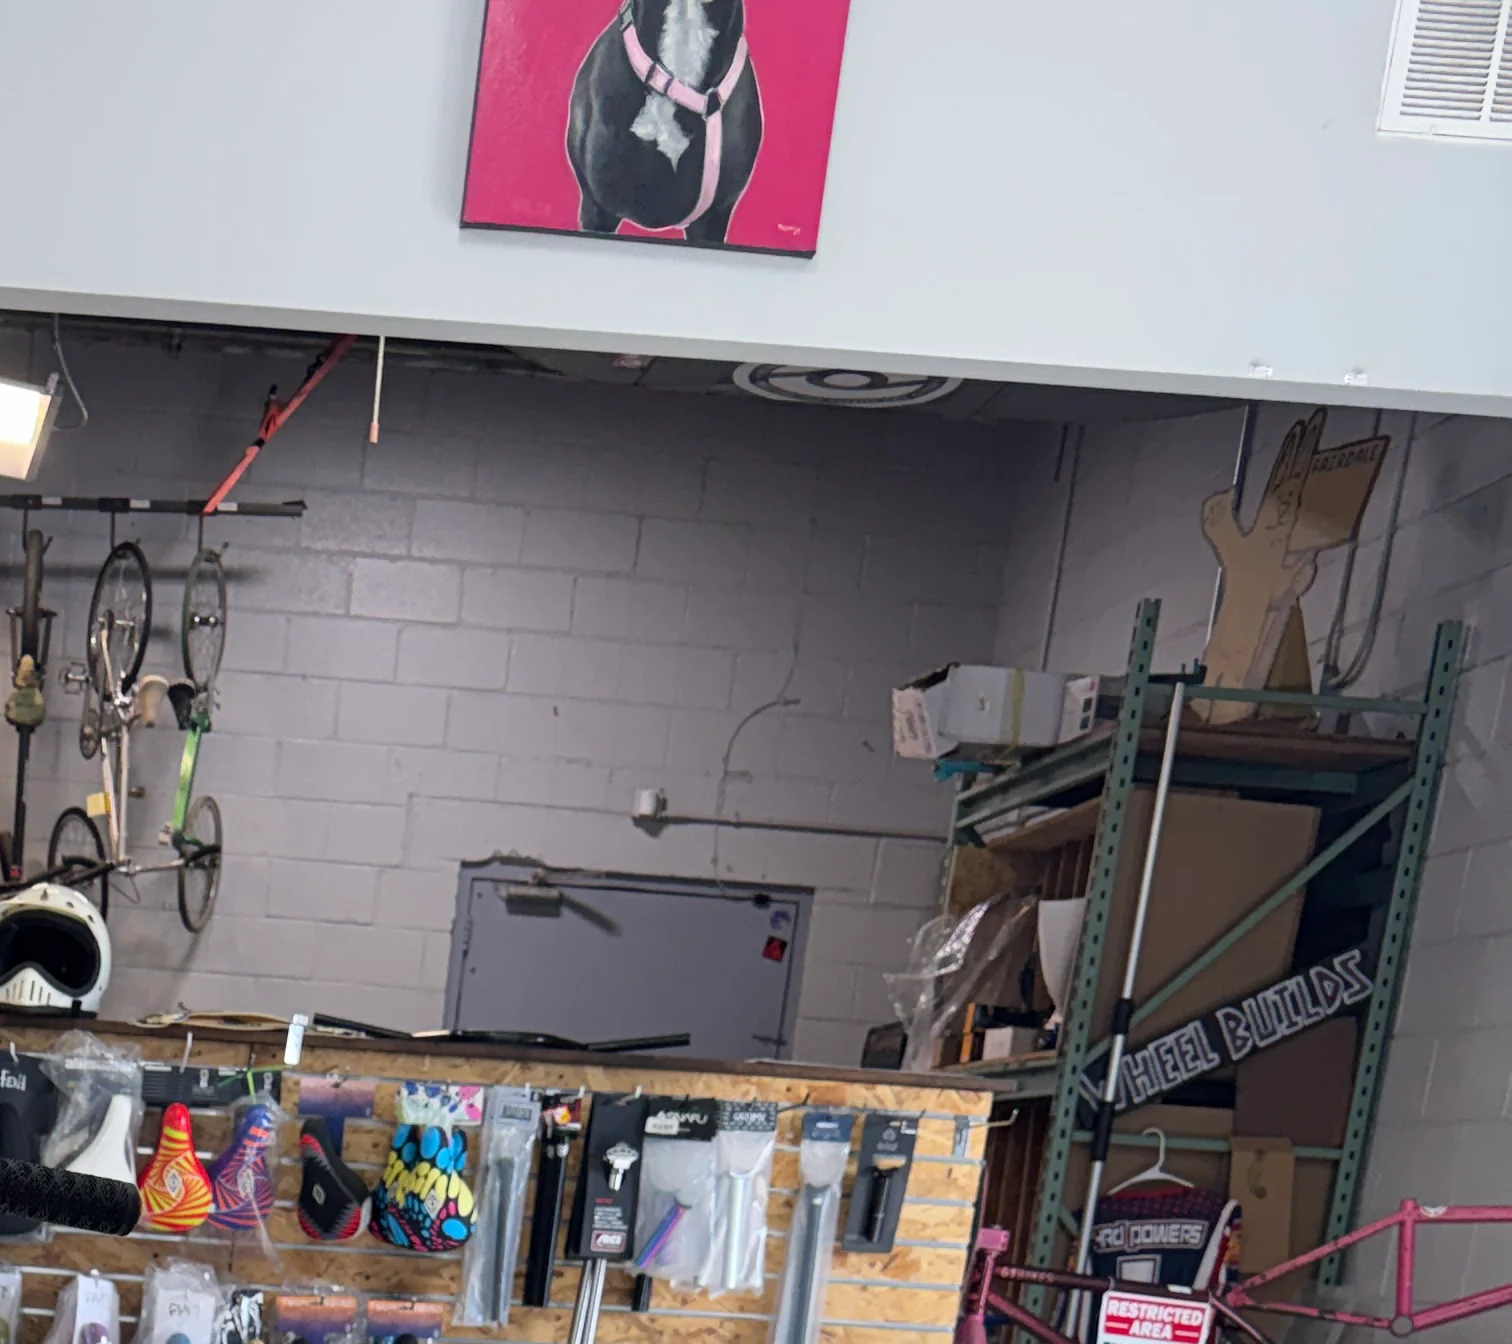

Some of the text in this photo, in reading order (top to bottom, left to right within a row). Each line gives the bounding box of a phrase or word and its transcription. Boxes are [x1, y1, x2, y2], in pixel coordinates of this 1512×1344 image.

[1215, 948, 1374, 1062] BUILDS
[1129, 1222, 1203, 1248] POWERS
[1106, 1299, 1204, 1327] RESTRICTED
[1128, 1320, 1174, 1341] AREA
